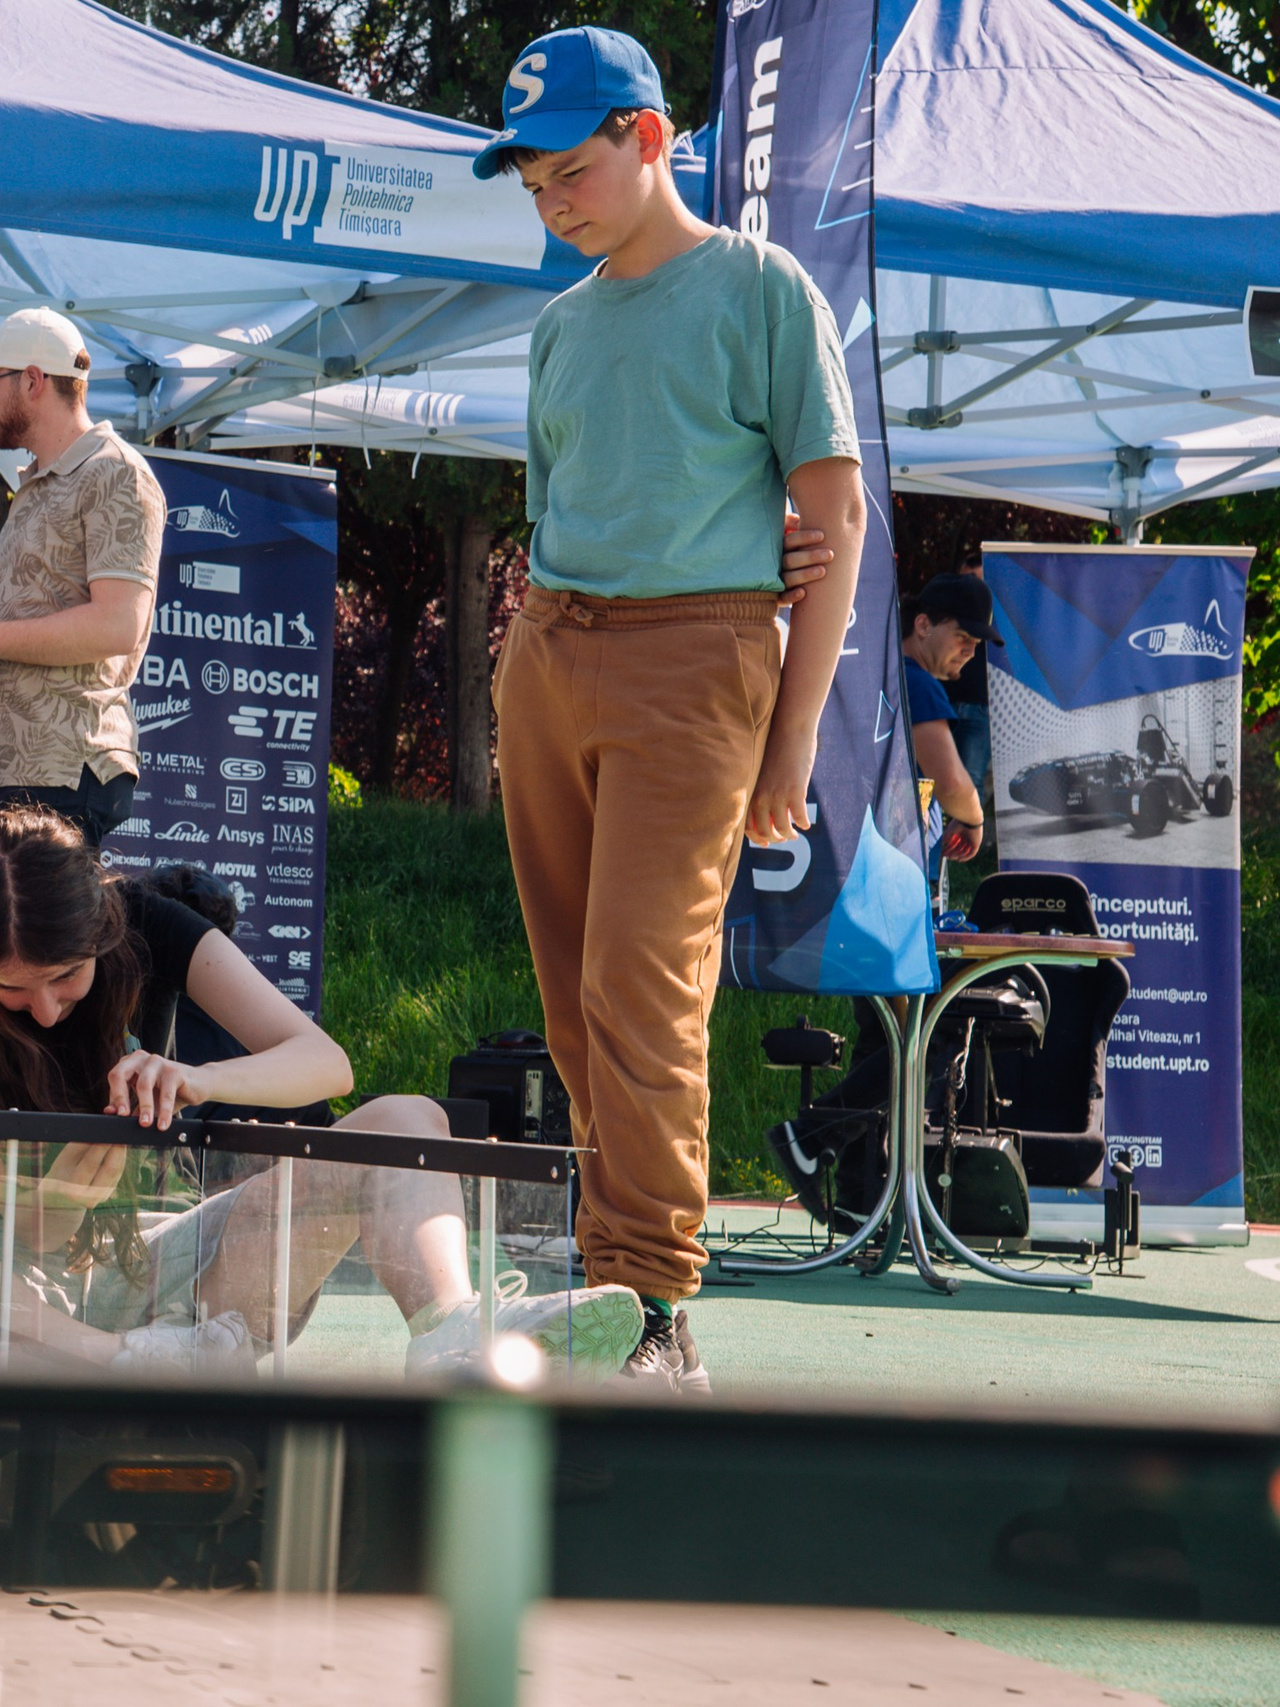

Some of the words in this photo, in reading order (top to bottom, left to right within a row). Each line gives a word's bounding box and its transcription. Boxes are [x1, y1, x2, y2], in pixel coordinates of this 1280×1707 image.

[509, 53, 547, 114] S
[346, 157, 433, 190] Universitatea
[342, 183, 414, 213] Politehnica
[338, 208, 401, 236] Timișoara
[233, 668, 319, 699] BOSCH
[273, 709, 317, 741] TE
[266, 742, 310, 752] connectivity
[157, 753, 205, 769] METAL
[154, 821, 210, 843] Linde
[217, 824, 265, 847] Ansys
[273, 824, 314, 844] INAS
[213, 862, 257, 878] MOTUL
[264, 894, 313, 908] Autonom
[1138, 1030, 1181, 1046] Viteazu,
[1183, 1035, 1194, 1044] nr
[1195, 1032, 1201, 1044] 1
